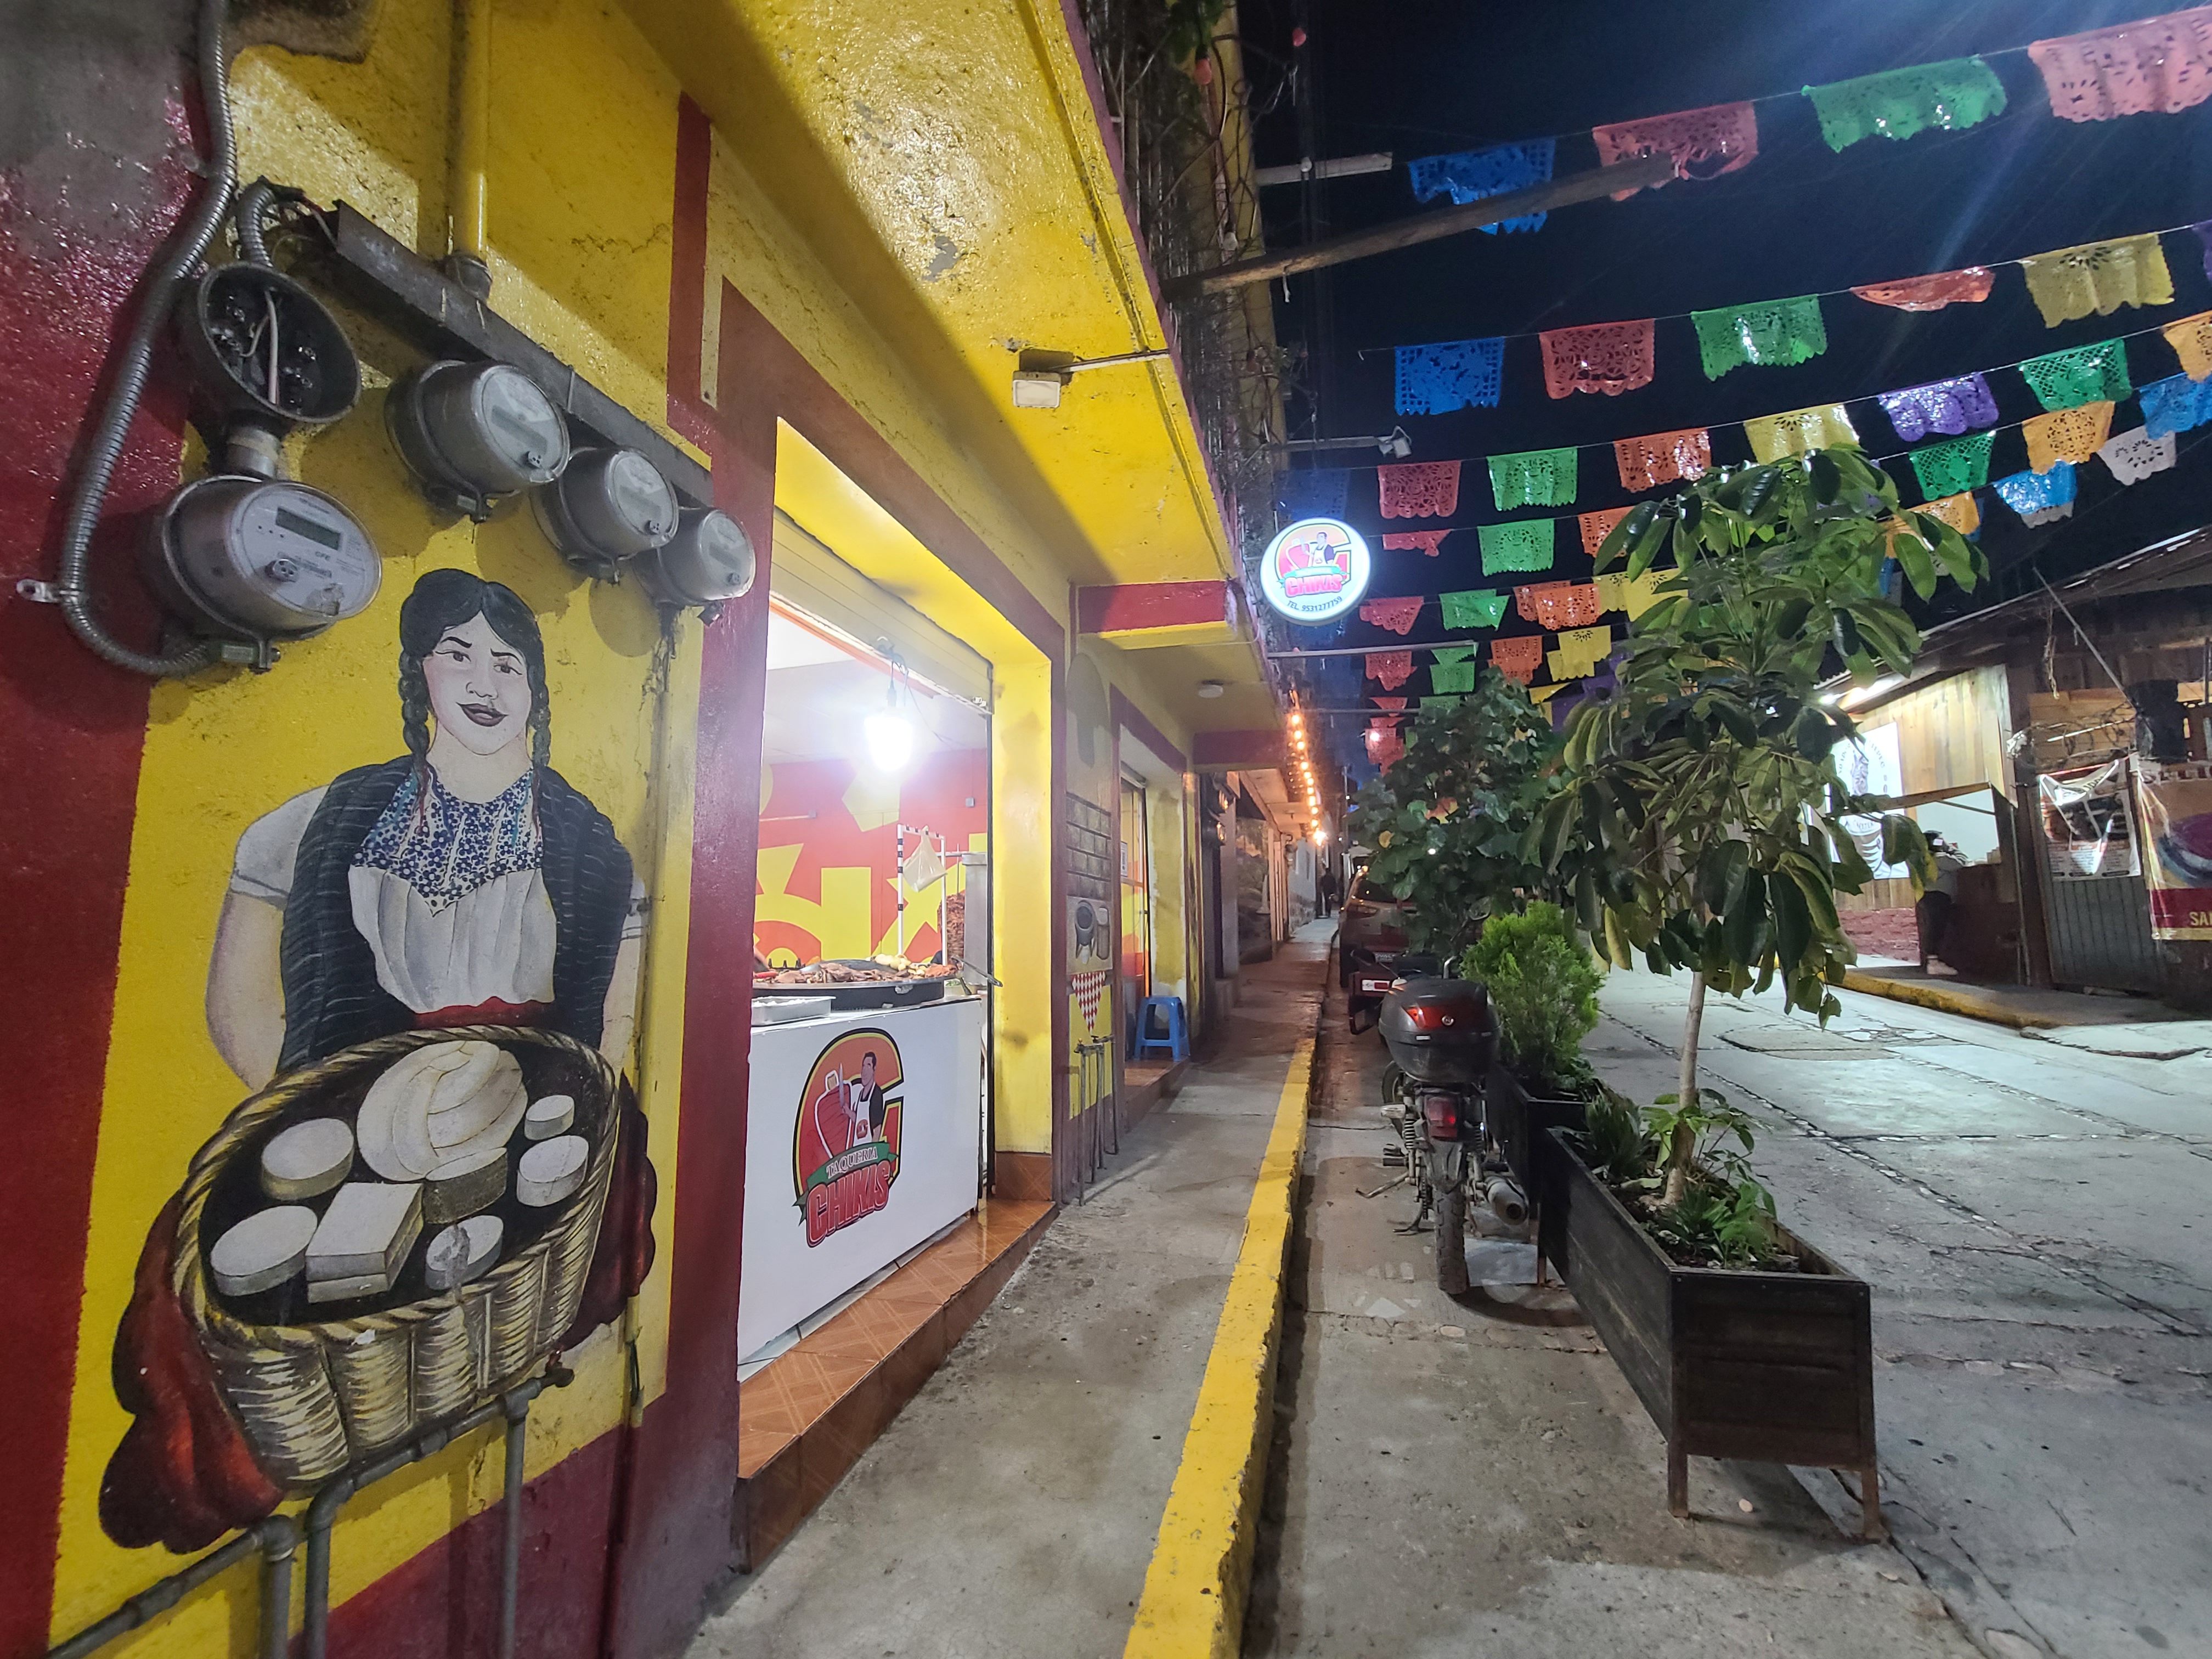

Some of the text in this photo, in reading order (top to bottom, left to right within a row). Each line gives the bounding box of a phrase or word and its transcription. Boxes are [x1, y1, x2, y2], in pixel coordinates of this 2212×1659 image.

[1284, 574, 1343, 597] CHIKIS
[1301, 596, 1343, 612] 9531277759
[826, 1146, 878, 1180] TAQUERIA
[807, 1161, 890, 1246] CHIKIS
